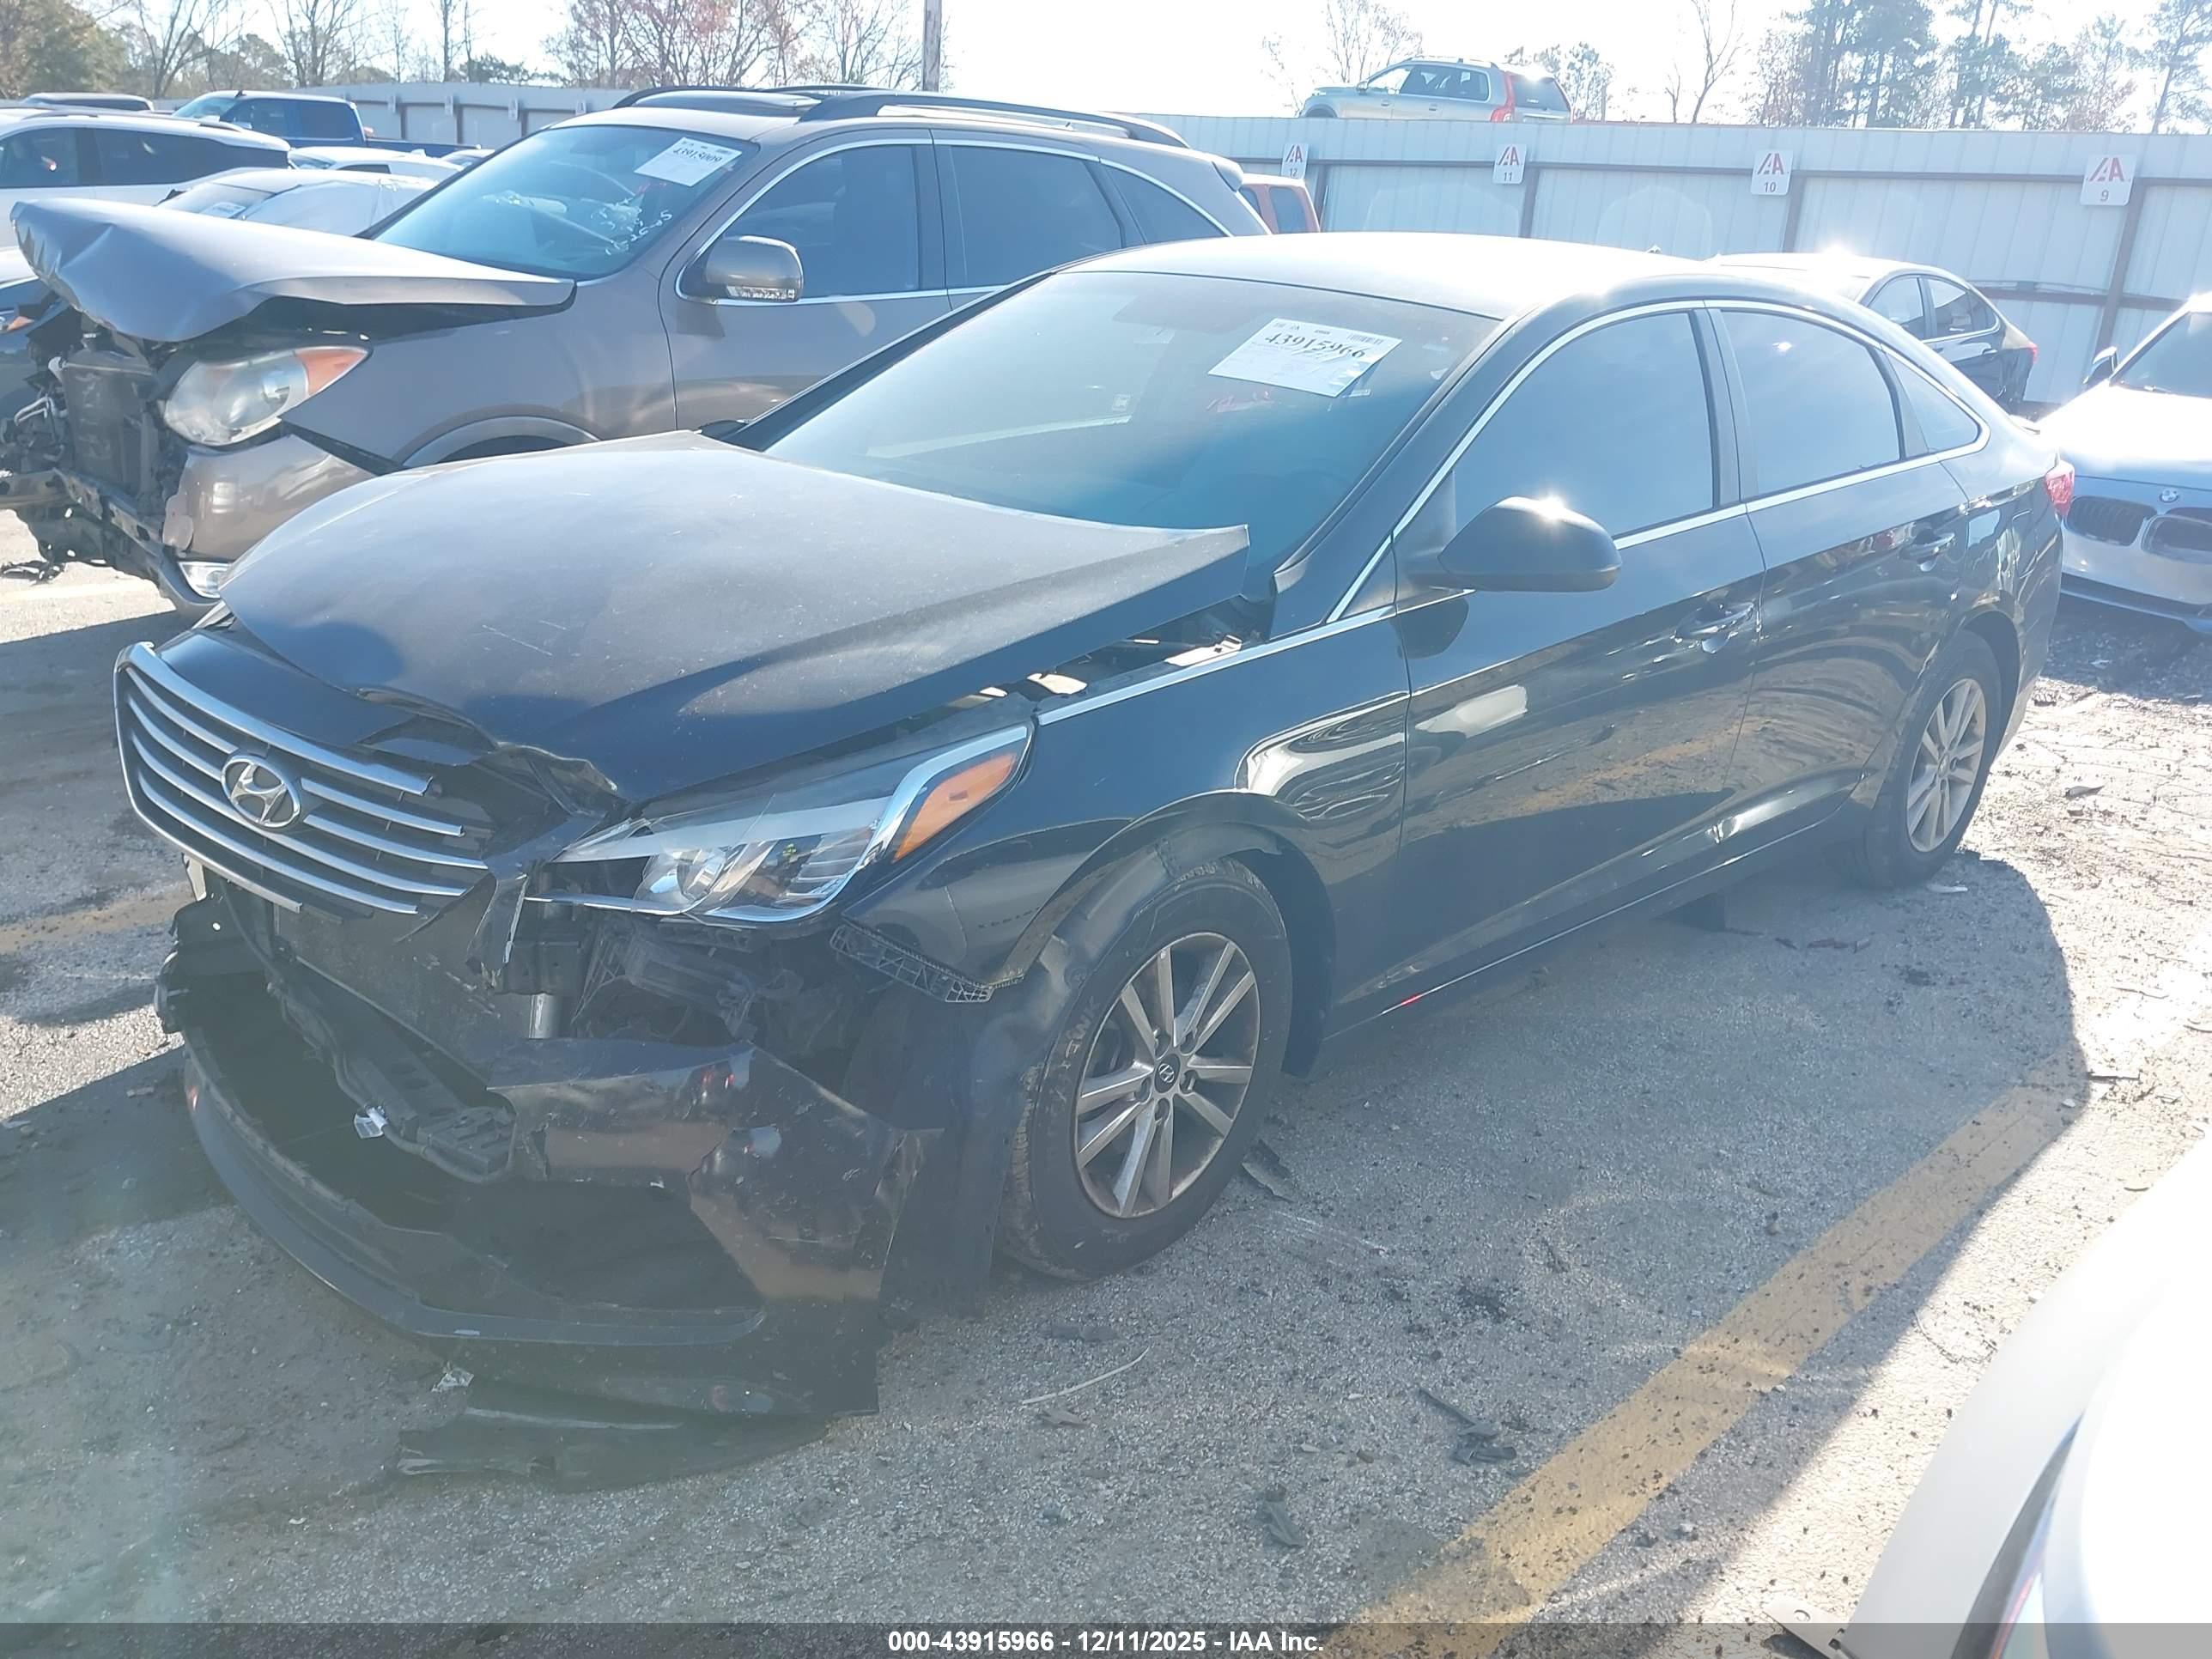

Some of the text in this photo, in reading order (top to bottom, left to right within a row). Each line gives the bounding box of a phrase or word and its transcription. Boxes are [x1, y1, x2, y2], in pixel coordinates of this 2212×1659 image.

[1289, 167, 1298, 177] 12
[1504, 172, 1513, 182] 11
[1764, 181, 1777, 193] 10
[2100, 190, 2110, 202] 9
[1265, 331, 1368, 359] 43915966
